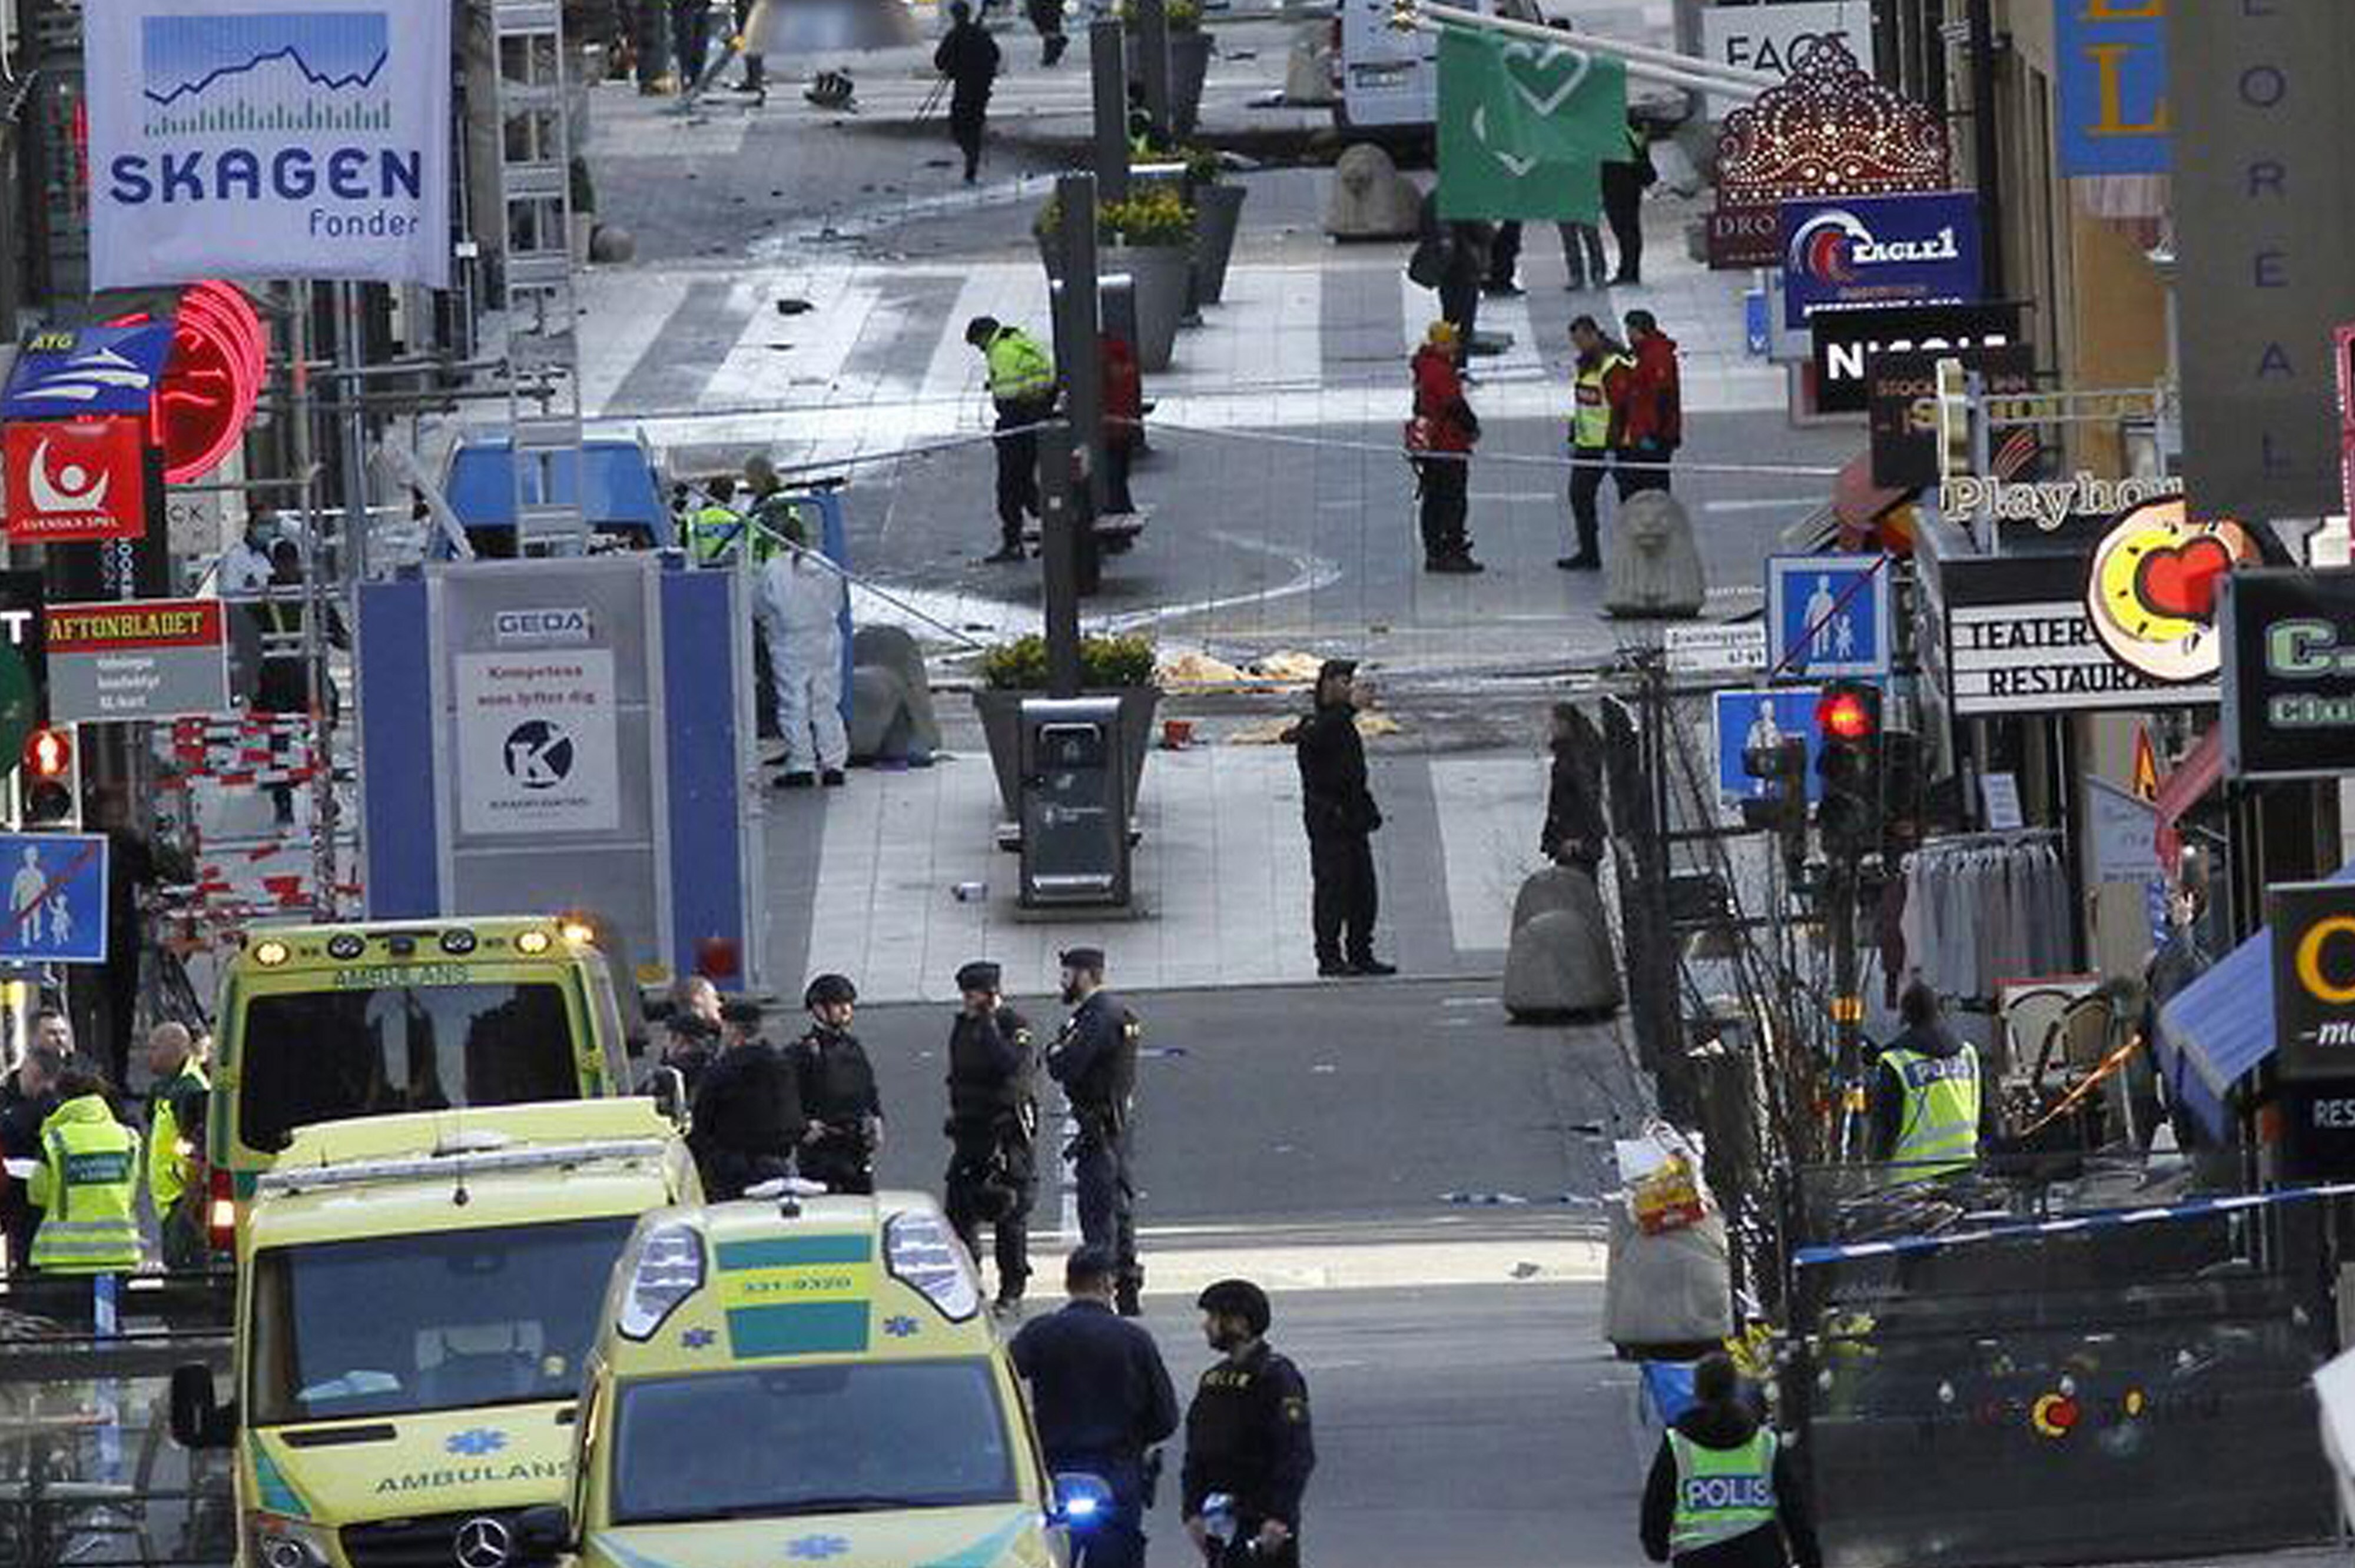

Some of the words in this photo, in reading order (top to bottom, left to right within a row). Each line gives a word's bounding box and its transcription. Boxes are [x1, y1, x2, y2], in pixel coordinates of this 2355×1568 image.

[1727, 32, 1849, 77] FAC
[110, 147, 422, 205] SKAGEN
[2239, 0, 2294, 471] OREAL
[49, 611, 203, 640] AFTONBLADET
[1972, 618, 2090, 649] TEATER
[1687, 1478, 1772, 1507] POLIS
